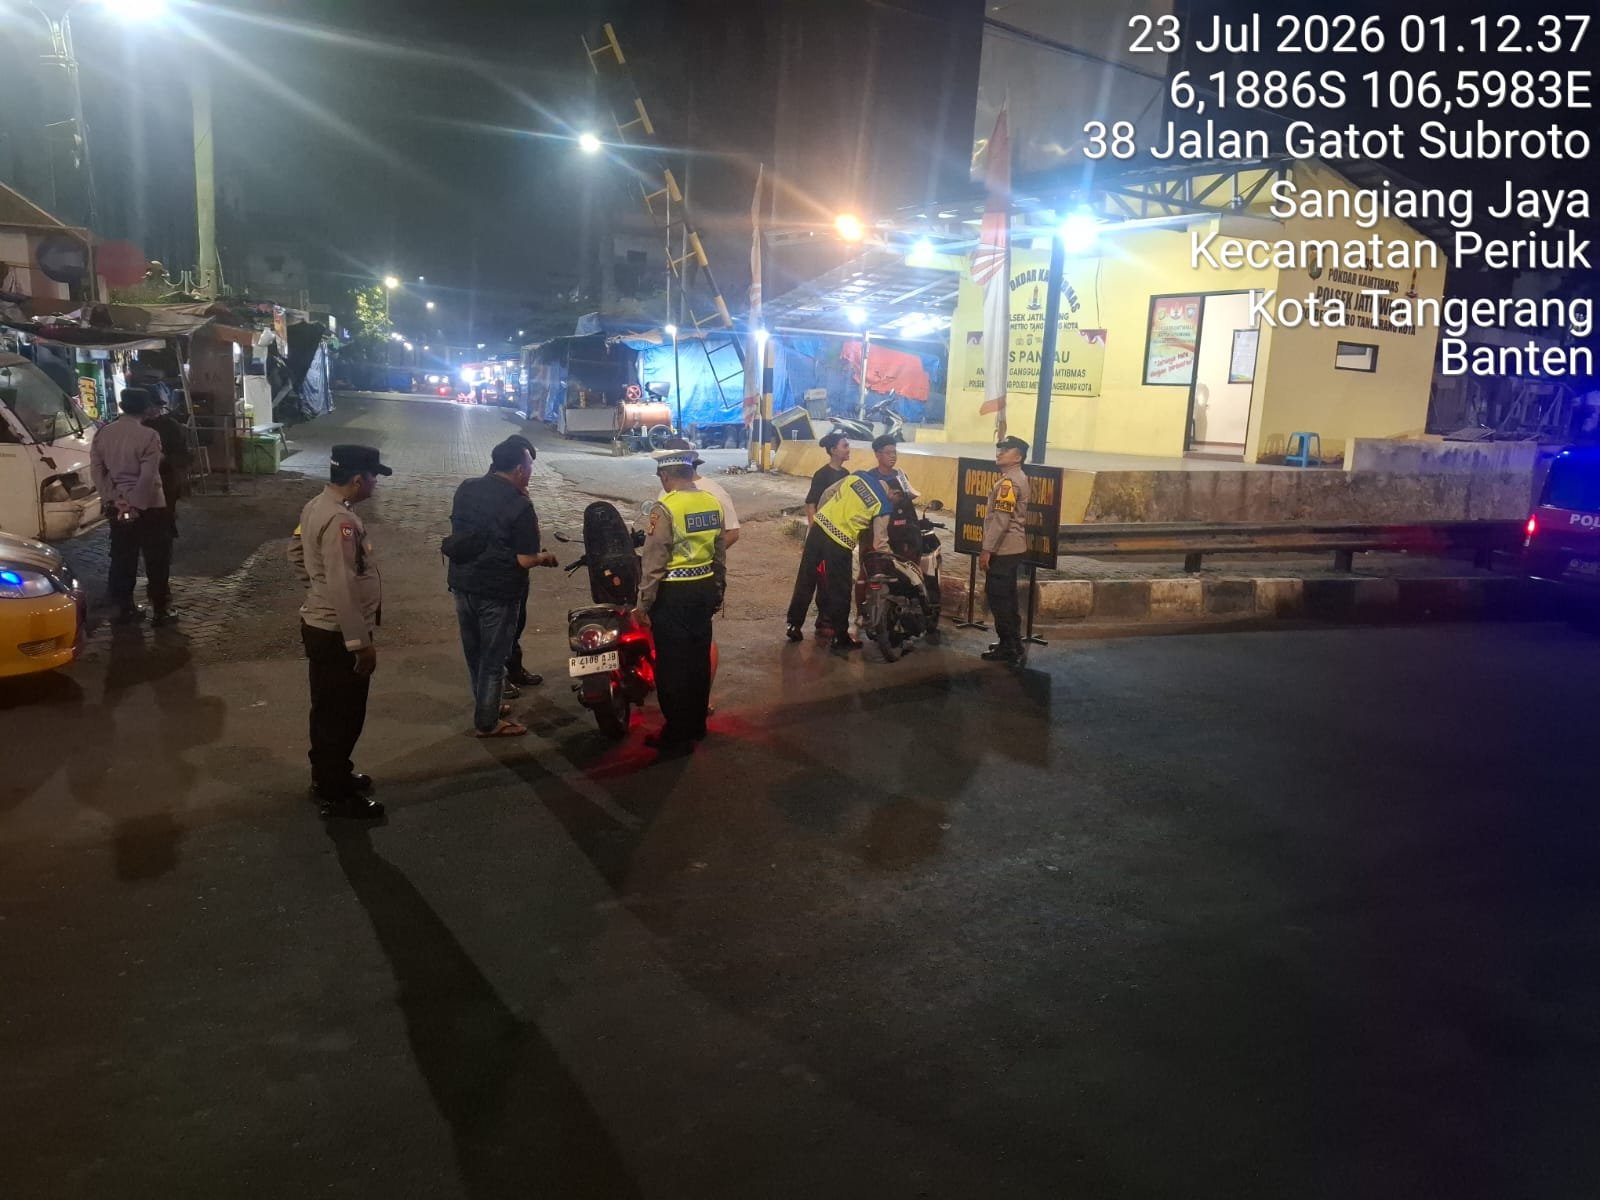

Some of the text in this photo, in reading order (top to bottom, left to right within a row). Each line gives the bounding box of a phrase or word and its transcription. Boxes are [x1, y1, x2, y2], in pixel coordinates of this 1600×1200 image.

[1009, 269, 1037, 292] OKDAR
[1328, 268, 1357, 285] POKDAR
[1019, 350, 1071, 364] PANAU
[1009, 368, 1087, 378] GANGGUA MTIBMAS
